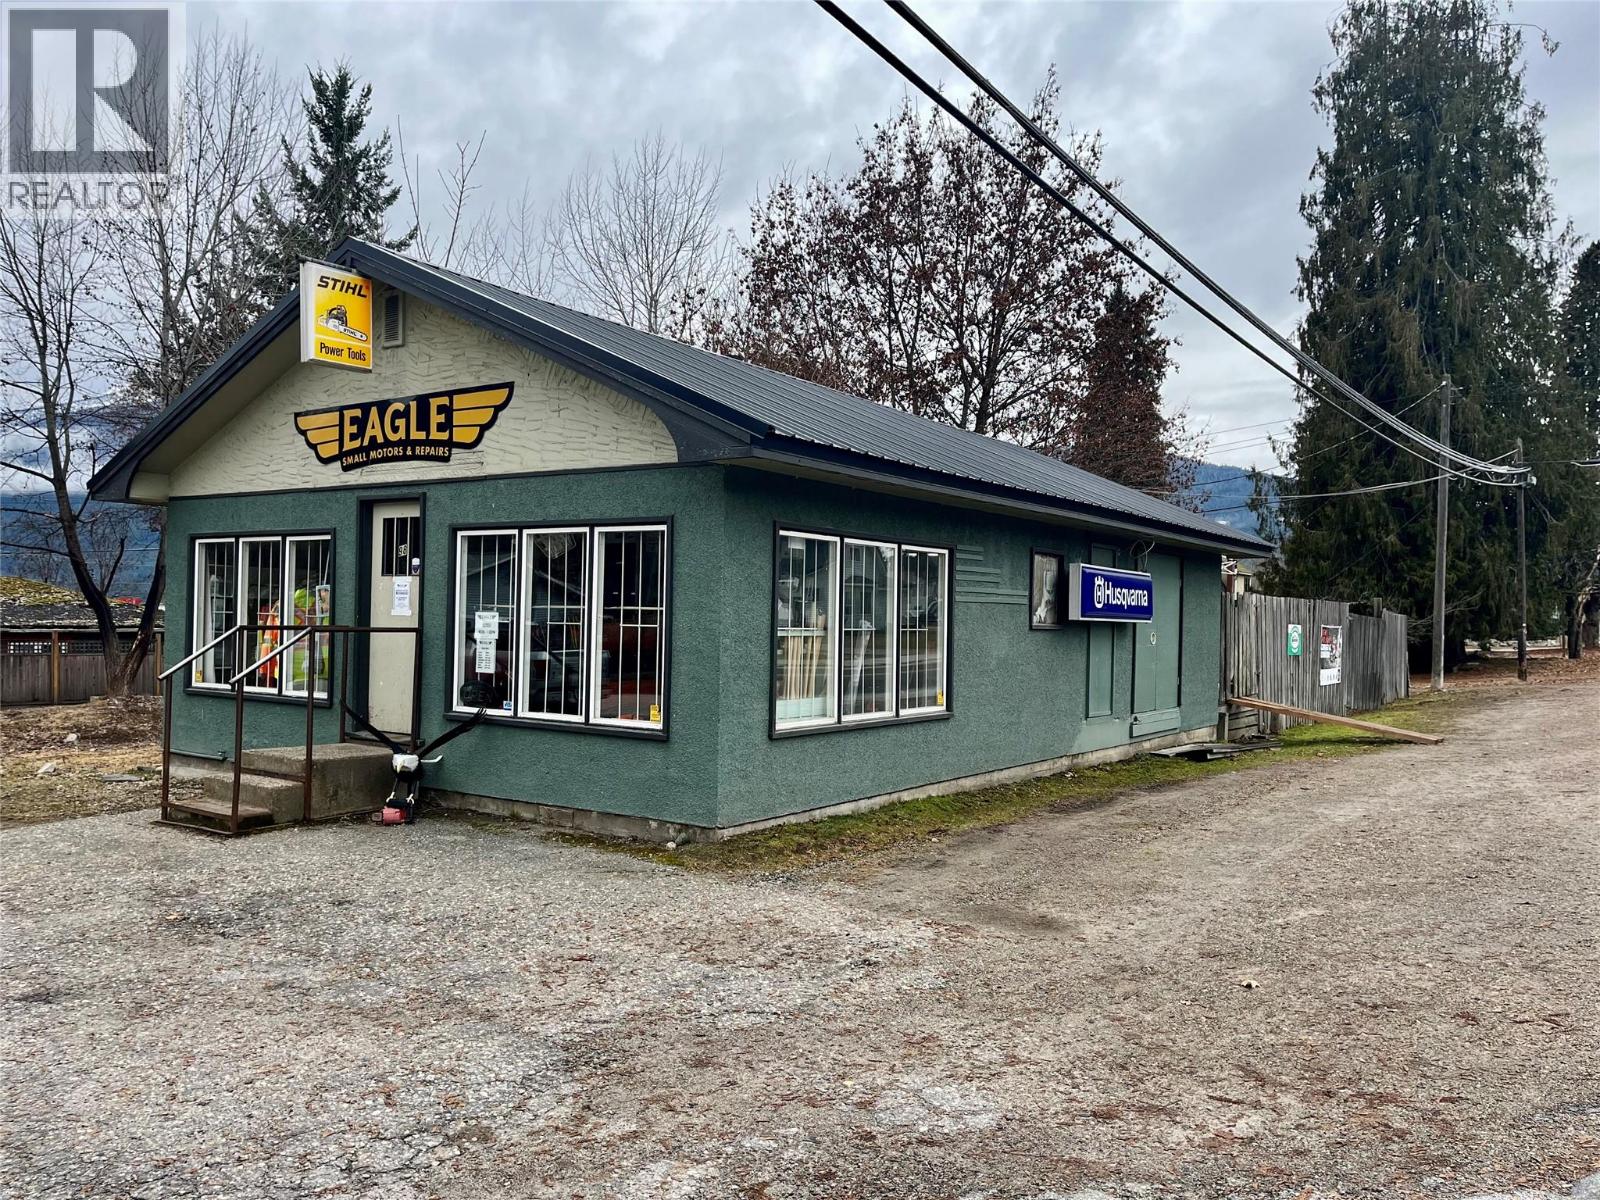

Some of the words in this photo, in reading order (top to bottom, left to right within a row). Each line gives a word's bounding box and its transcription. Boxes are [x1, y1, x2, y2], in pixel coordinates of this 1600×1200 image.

[317, 275, 367, 298] STIHL
[320, 342, 344, 357] Power
[347, 347, 366, 361] Tools
[342, 396, 450, 451] EAGLE
[342, 452, 367, 466] SMALL
[369, 447, 403, 459] MOTORS
[406, 446, 413, 456] &
[415, 446, 449, 457] REPAIRS
[1104, 581, 1149, 610] Husqvarna
